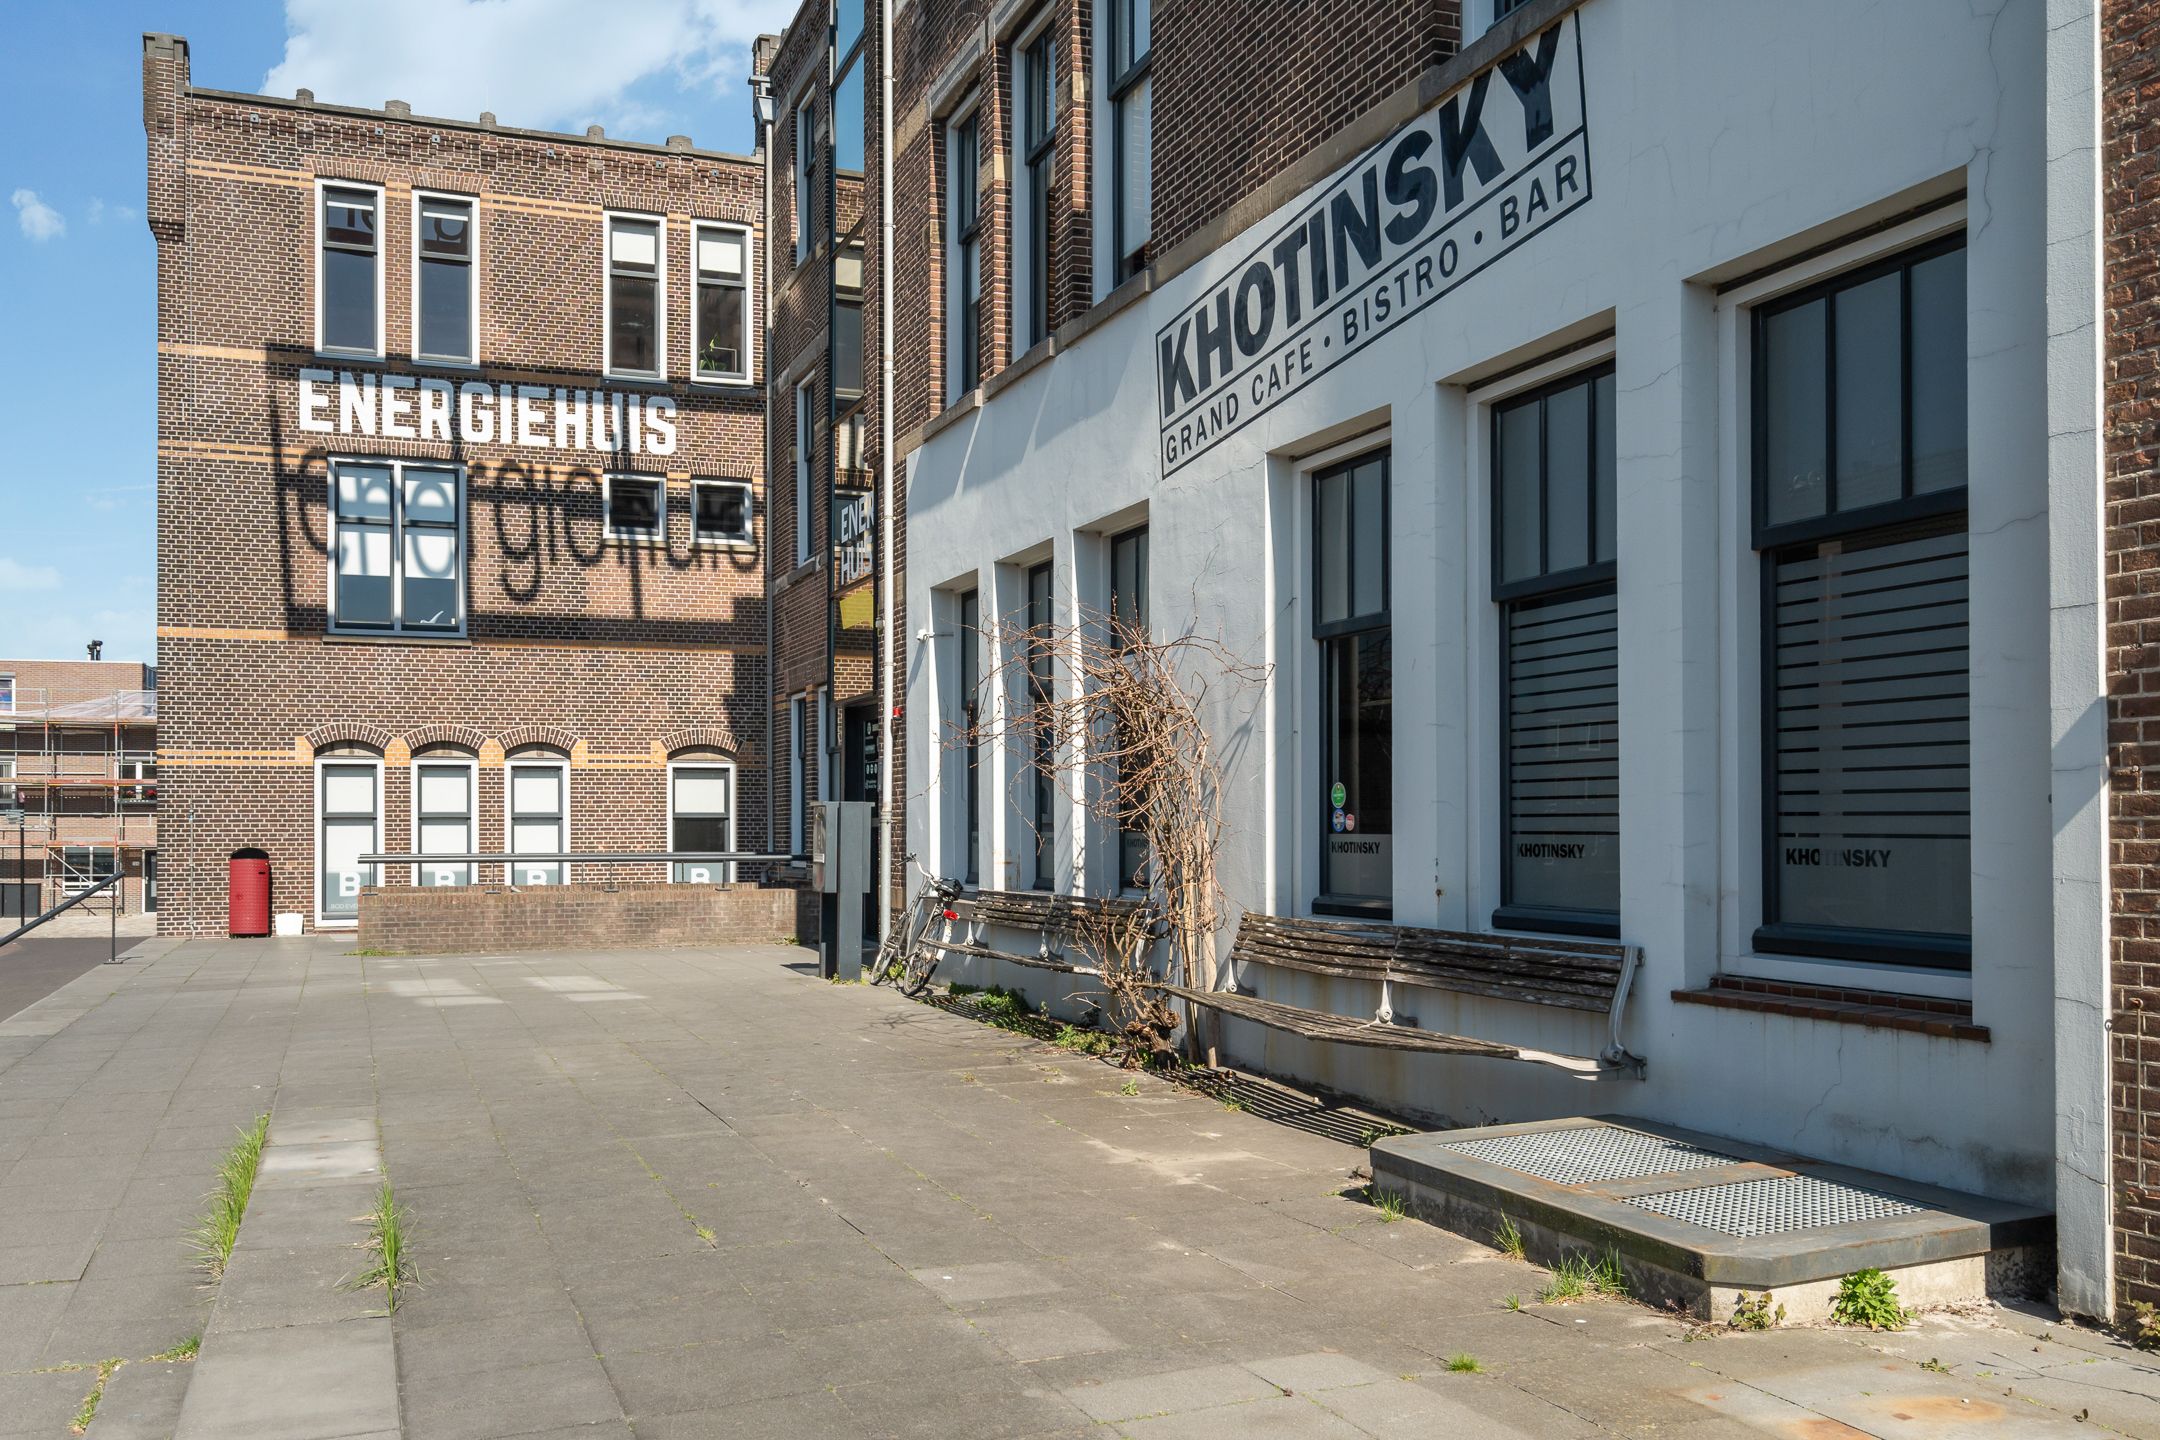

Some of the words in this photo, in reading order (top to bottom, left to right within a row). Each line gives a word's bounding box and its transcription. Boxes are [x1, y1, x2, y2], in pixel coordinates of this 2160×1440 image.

[1160, 20, 1562, 418] KHOTINSKY
[1165, 391, 1239, 465] GRAND
[1250, 337, 1314, 406] CAFE
[1343, 238, 1459, 347] BISTRO
[1499, 153, 1579, 241] BAR
[298, 367, 678, 456] ENERGIEHUIS
[1331, 840, 1381, 854] KHOTINSKY
[1517, 843, 1585, 859] KHOTINSKY
